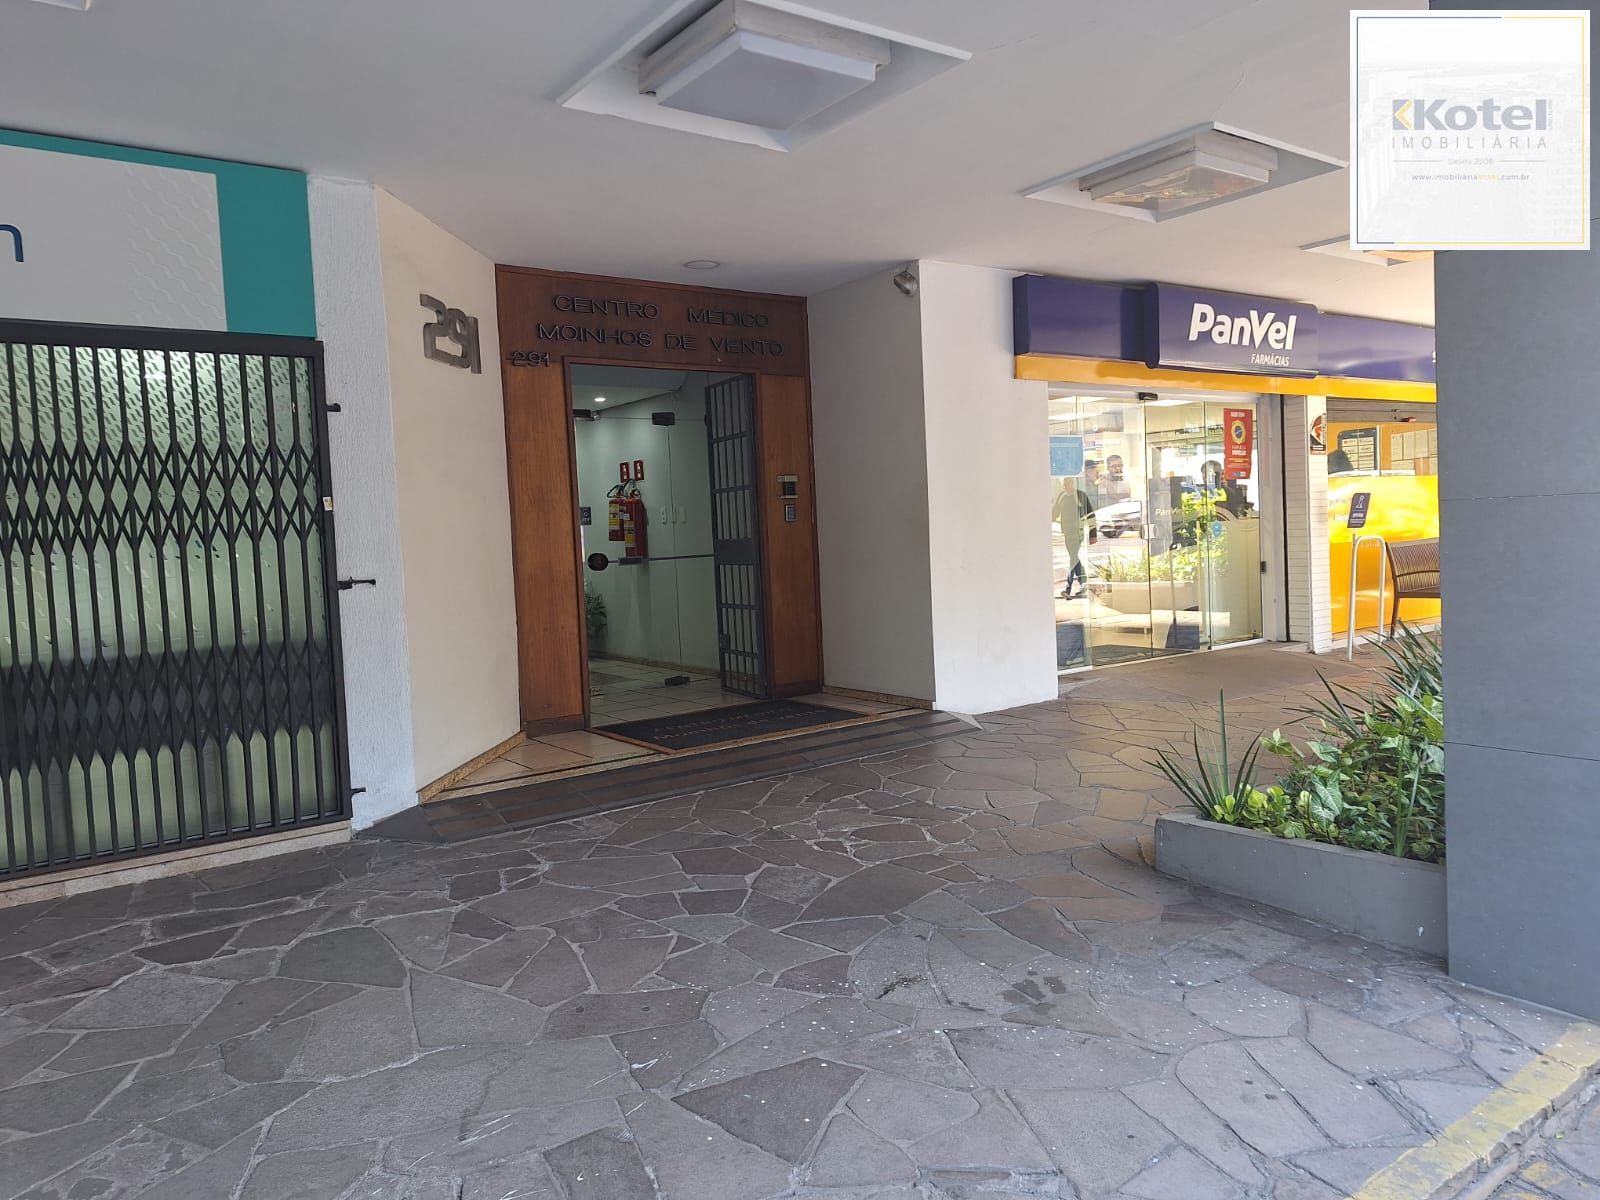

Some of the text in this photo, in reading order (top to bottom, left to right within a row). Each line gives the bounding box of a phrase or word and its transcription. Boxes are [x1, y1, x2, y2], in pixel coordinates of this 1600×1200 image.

[554, 295, 770, 328] CENTRO MÉDICO
[1188, 302, 1297, 350] PanVel
[419, 293, 482, 374] 291
[537, 323, 784, 357] MOINHOS DE VENTO
[511, 350, 551, 368] 291
[1250, 352, 1291, 367] FARMÁCIAS
